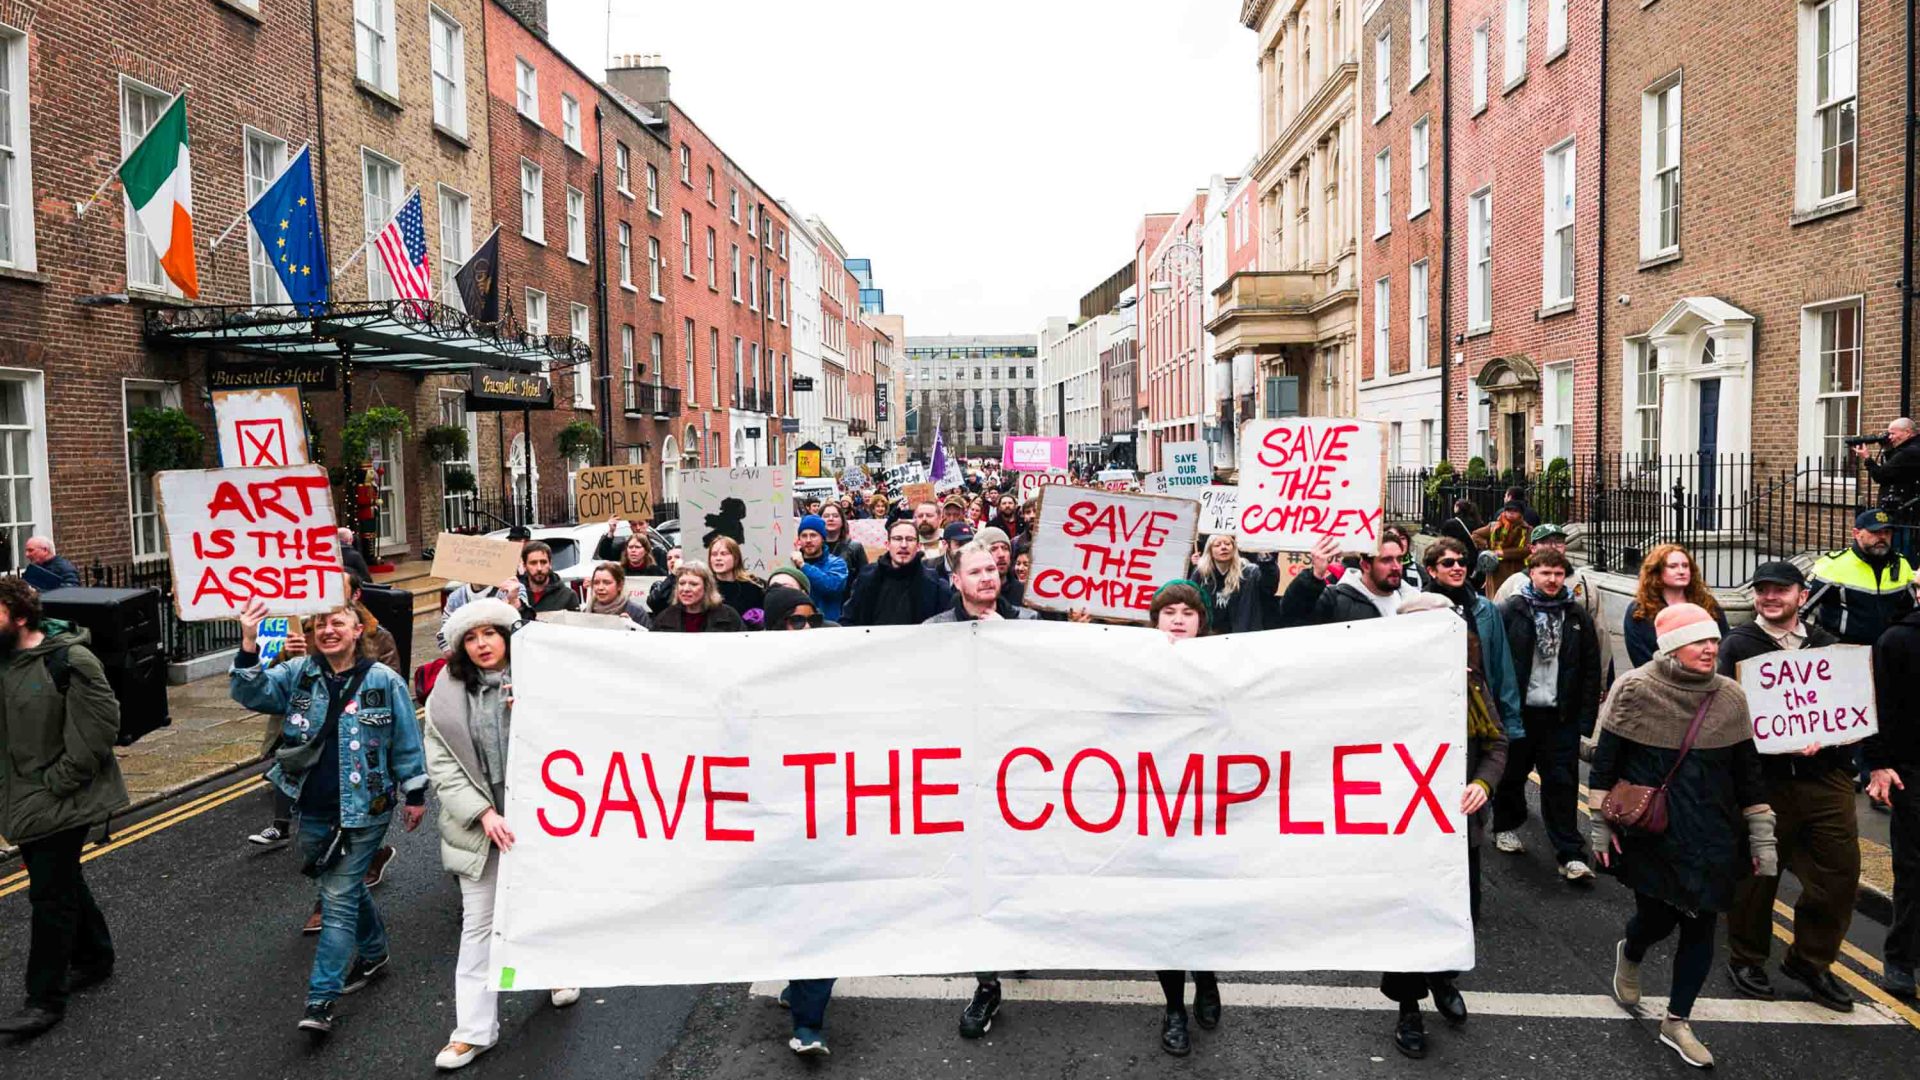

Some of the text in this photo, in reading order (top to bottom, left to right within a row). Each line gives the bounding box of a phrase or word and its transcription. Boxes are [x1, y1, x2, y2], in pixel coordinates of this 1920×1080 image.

[212, 366, 328, 385] Buswells Hotel
[482, 375, 541, 397] Buswells Hotel
[1174, 453, 1198, 463] SAVE
[1257, 425, 1359, 467] SAVE
[580, 469, 645, 490] SAVE THE
[1168, 475, 1209, 486] STUDIOS
[1177, 465, 1197, 474] OUR
[1270, 466, 1337, 501] THE
[208, 476, 330, 523] ART
[579, 490, 651, 518] COMPLEX
[1063, 501, 1177, 547] SAVE
[1241, 505, 1383, 540] COMPLEX
[193, 526, 338, 563] IS THE
[1074, 543, 1157, 583] THE
[192, 564, 343, 609] ASSET
[1033, 570, 1161, 610] COMPLE
[1783, 688, 1818, 711] the
[535, 741, 1456, 842] SAVE THE COMPLEX
